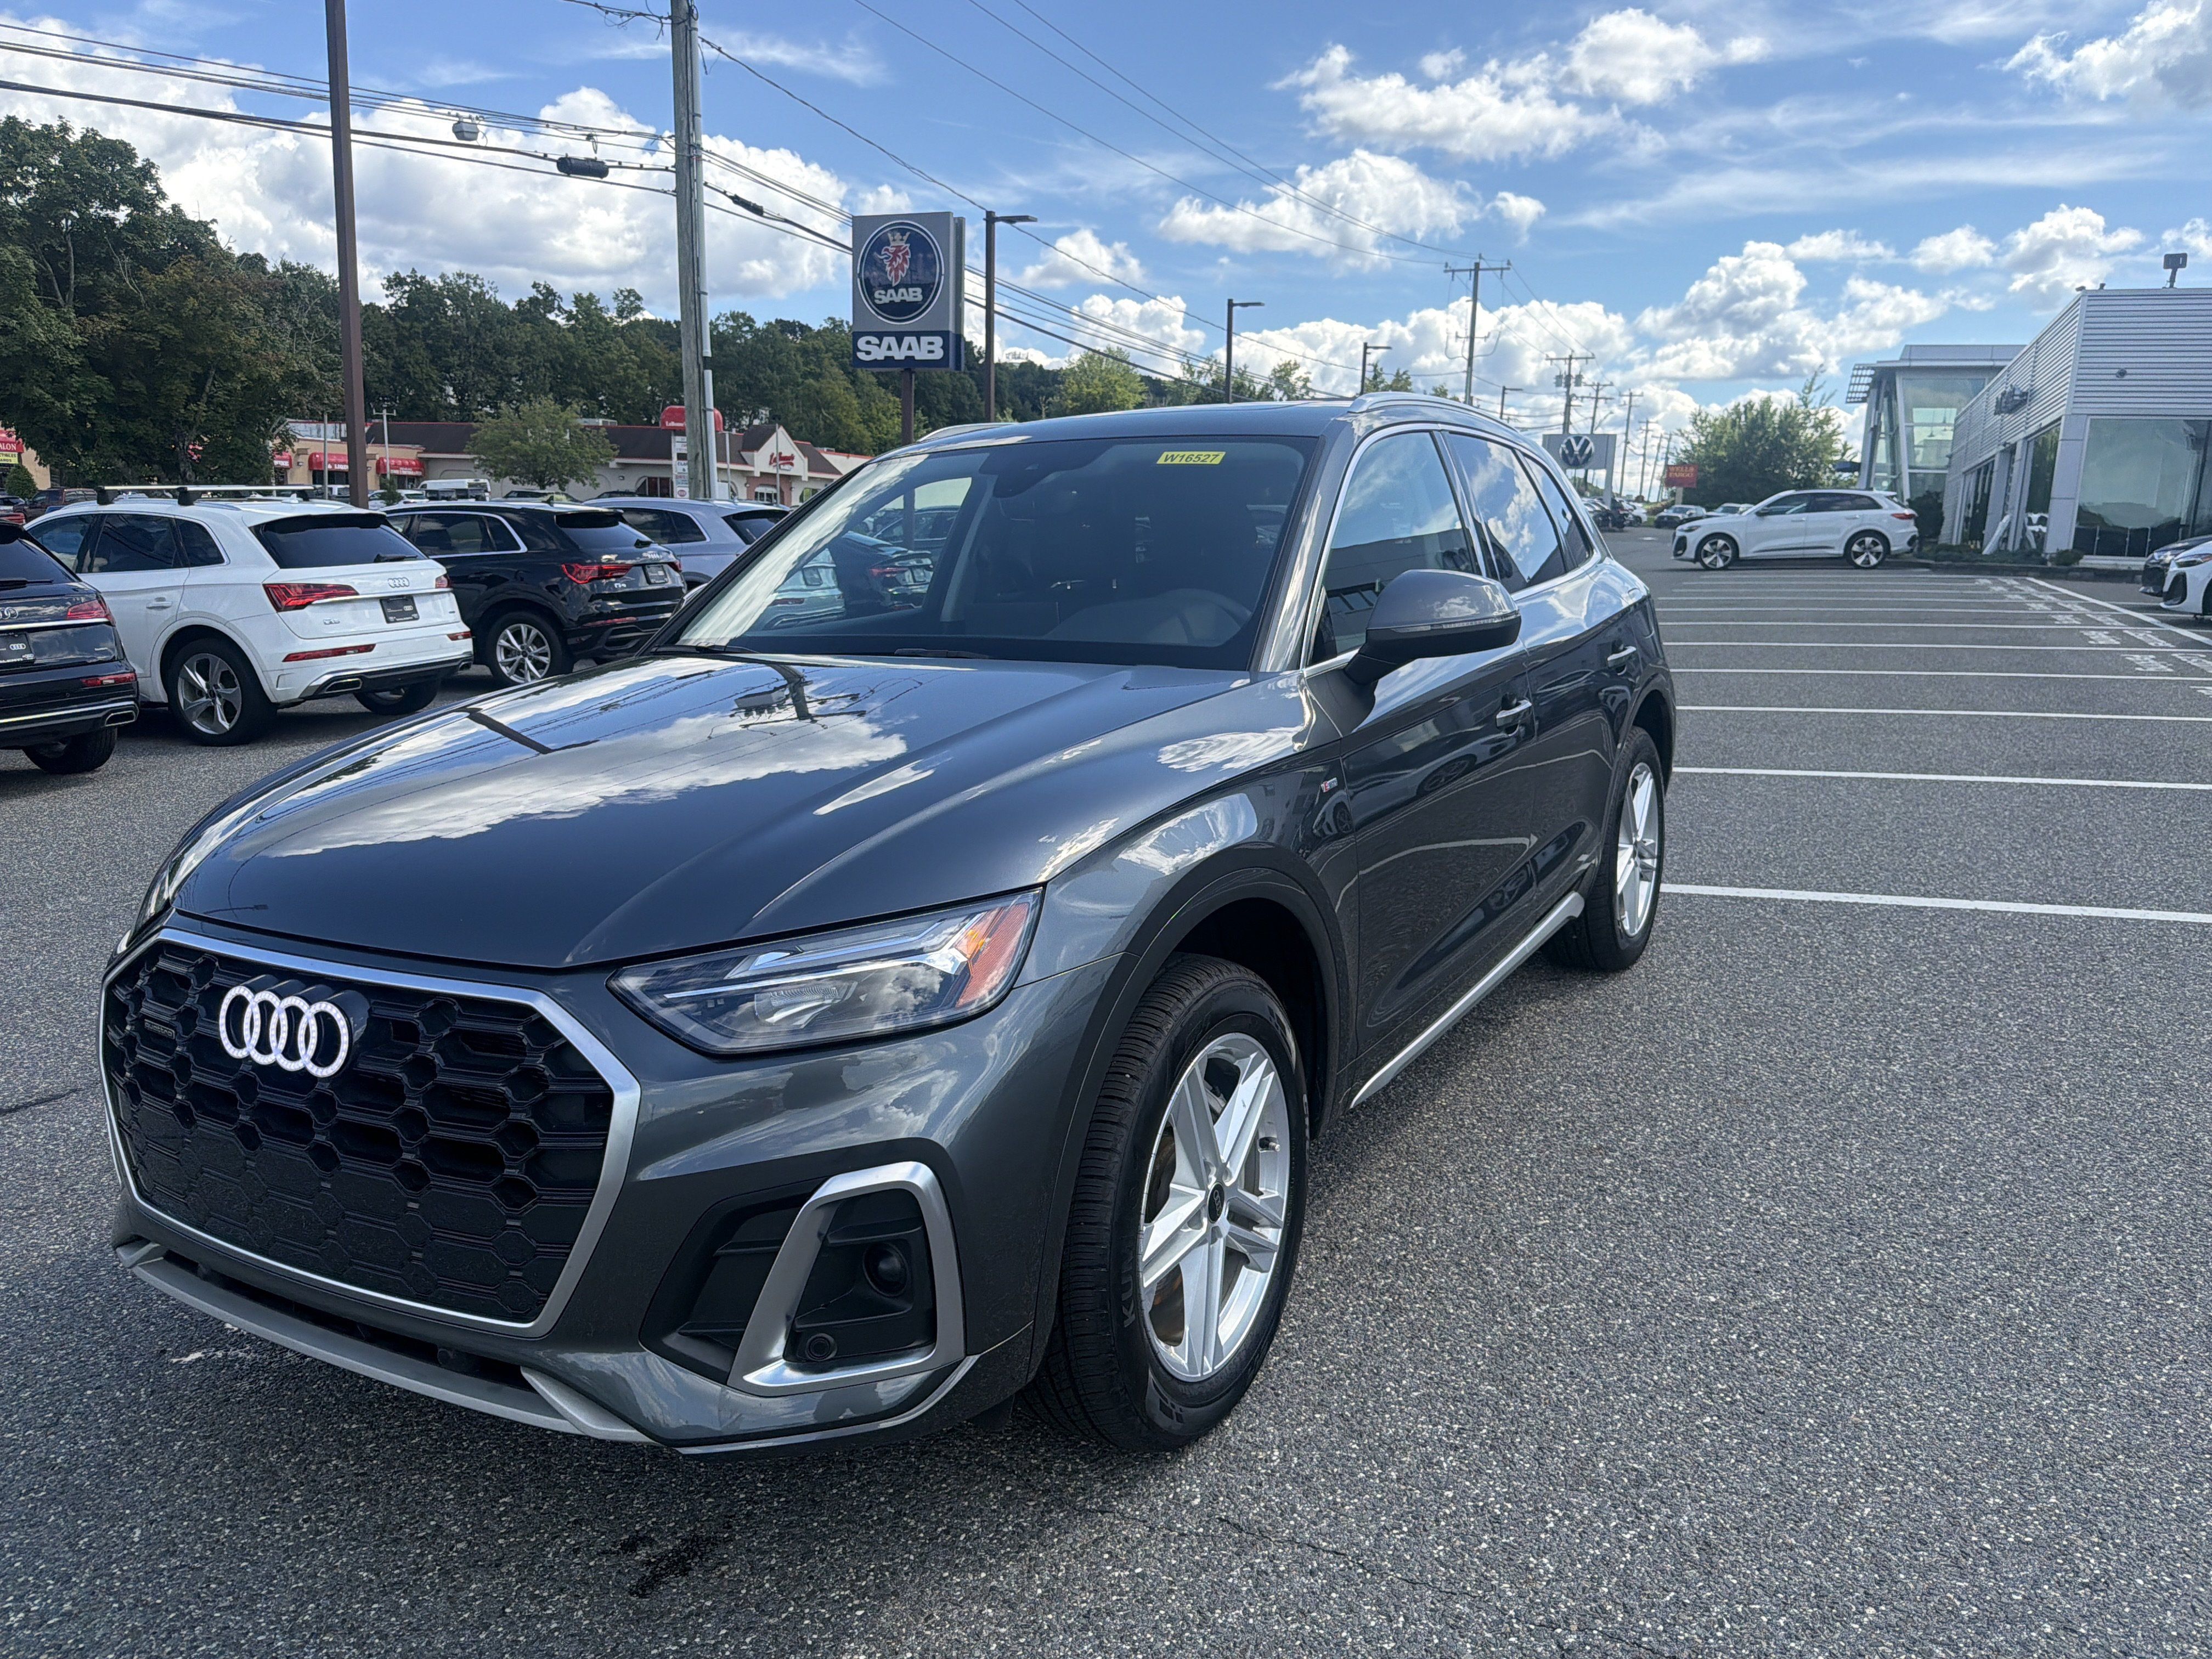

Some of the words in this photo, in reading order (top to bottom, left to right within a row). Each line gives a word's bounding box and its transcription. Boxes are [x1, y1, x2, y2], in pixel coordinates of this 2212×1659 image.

[874, 287, 923, 304] SAAB
[856, 336, 944, 361] SAAB
[1164, 454, 1220, 462] W16527
